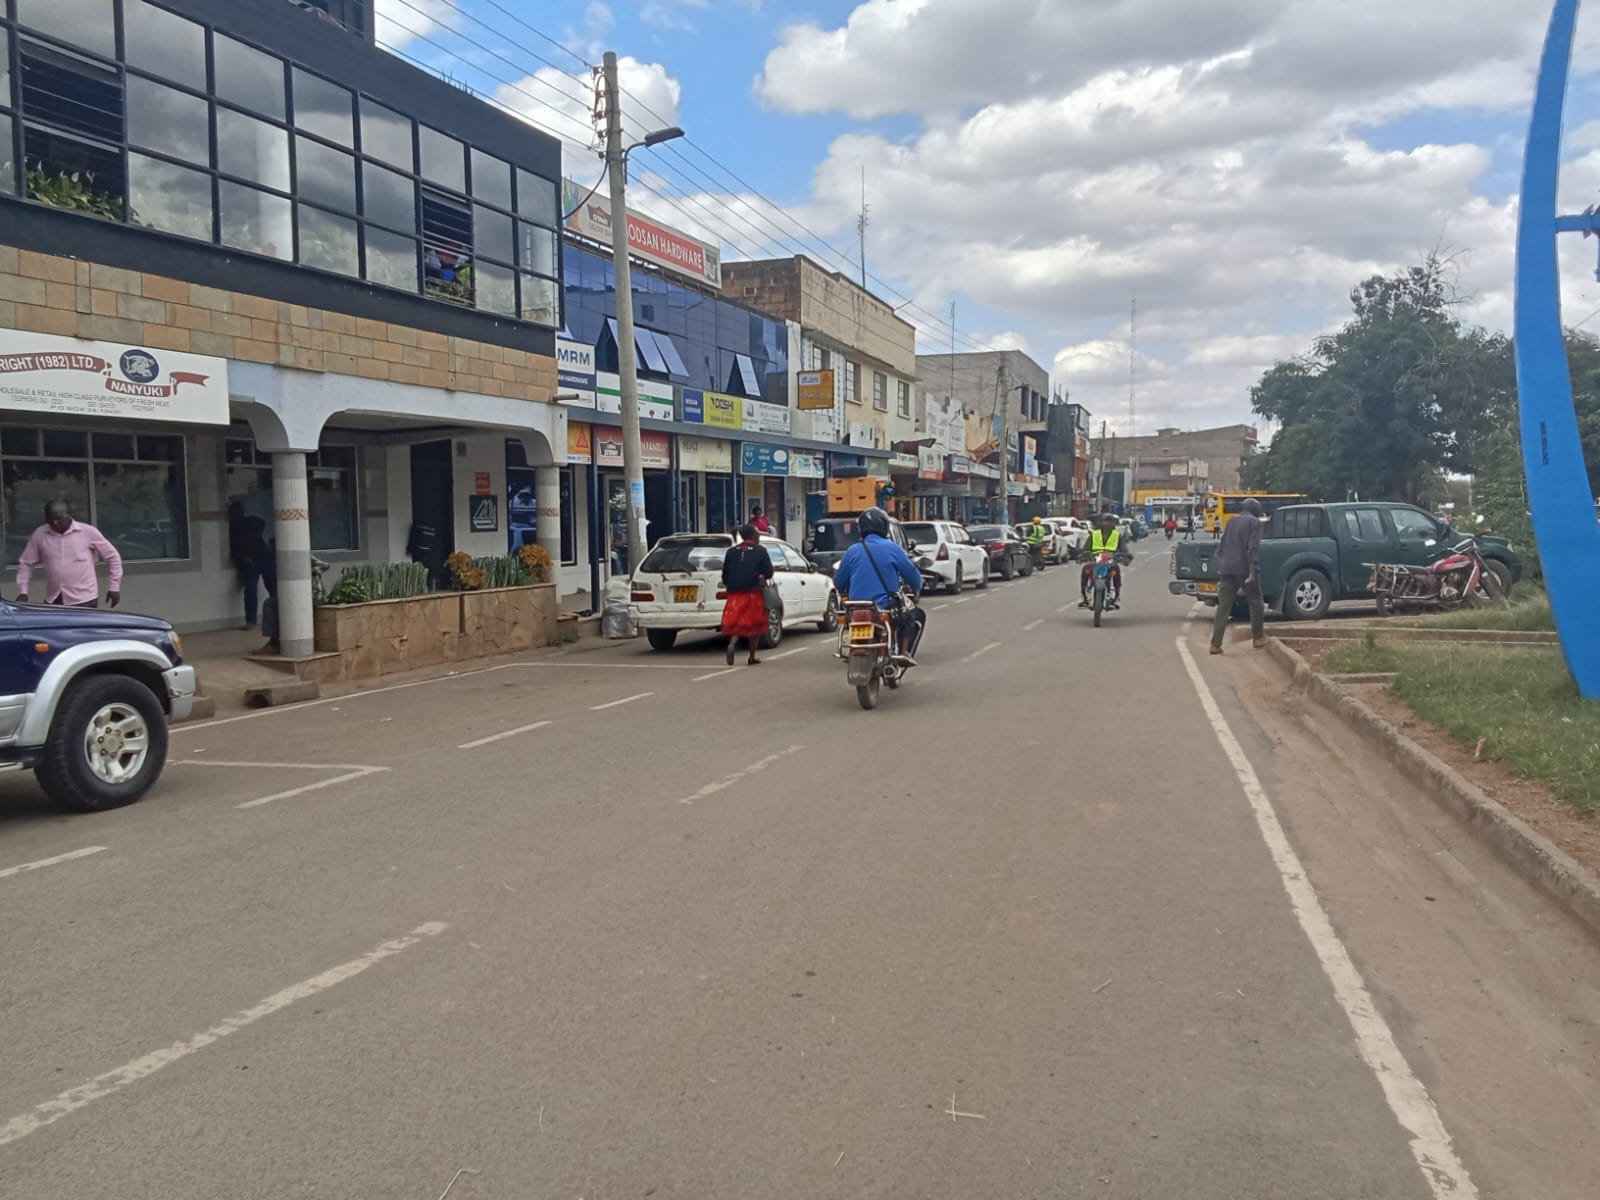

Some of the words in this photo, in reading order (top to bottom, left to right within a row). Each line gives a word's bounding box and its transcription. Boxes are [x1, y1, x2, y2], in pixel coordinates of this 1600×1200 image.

[627, 223, 659, 251] ODSAN
[660, 236, 703, 269] HARDWARE
[0, 357, 33, 371] RIGHT
[35, 355, 70, 371] (1982)
[72, 356, 97, 371] LTD.
[557, 347, 591, 366] MRM
[110, 380, 164, 397] NANYUKI
[36, 389, 57, 398] RETAIL
[58, 391, 73, 399] HIGH
[136, 398, 155, 406] FRESH
[155, 399, 170, 408] MEAT
